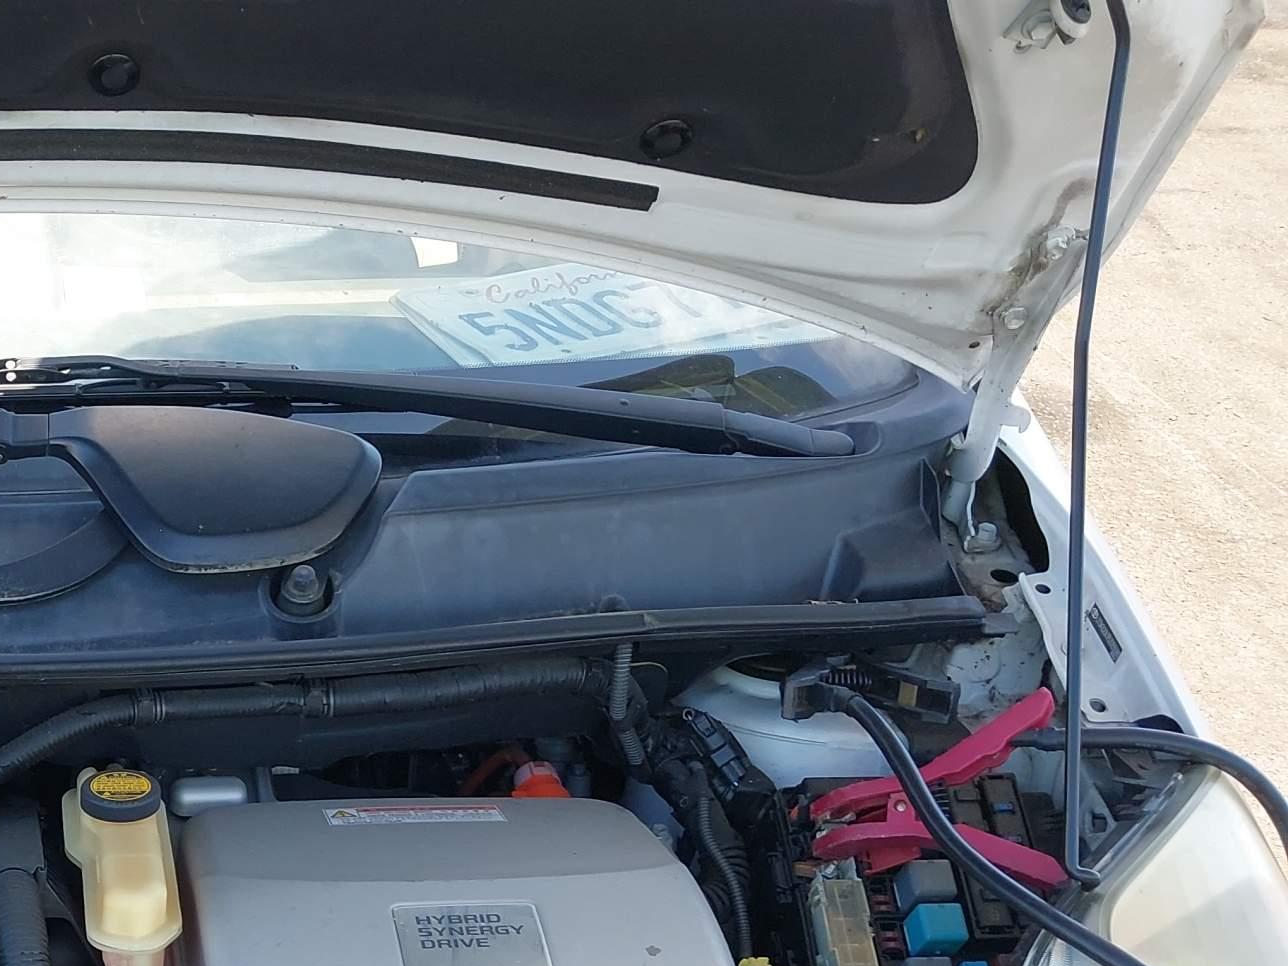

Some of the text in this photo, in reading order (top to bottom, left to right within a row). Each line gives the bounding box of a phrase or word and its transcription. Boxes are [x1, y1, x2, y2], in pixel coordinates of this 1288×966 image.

[458, 280, 745, 351] 5NDG7
[415, 914, 501, 925] HYBRID
[417, 925, 524, 937] SYNERGY
[420, 938, 490, 949] DRIVE
